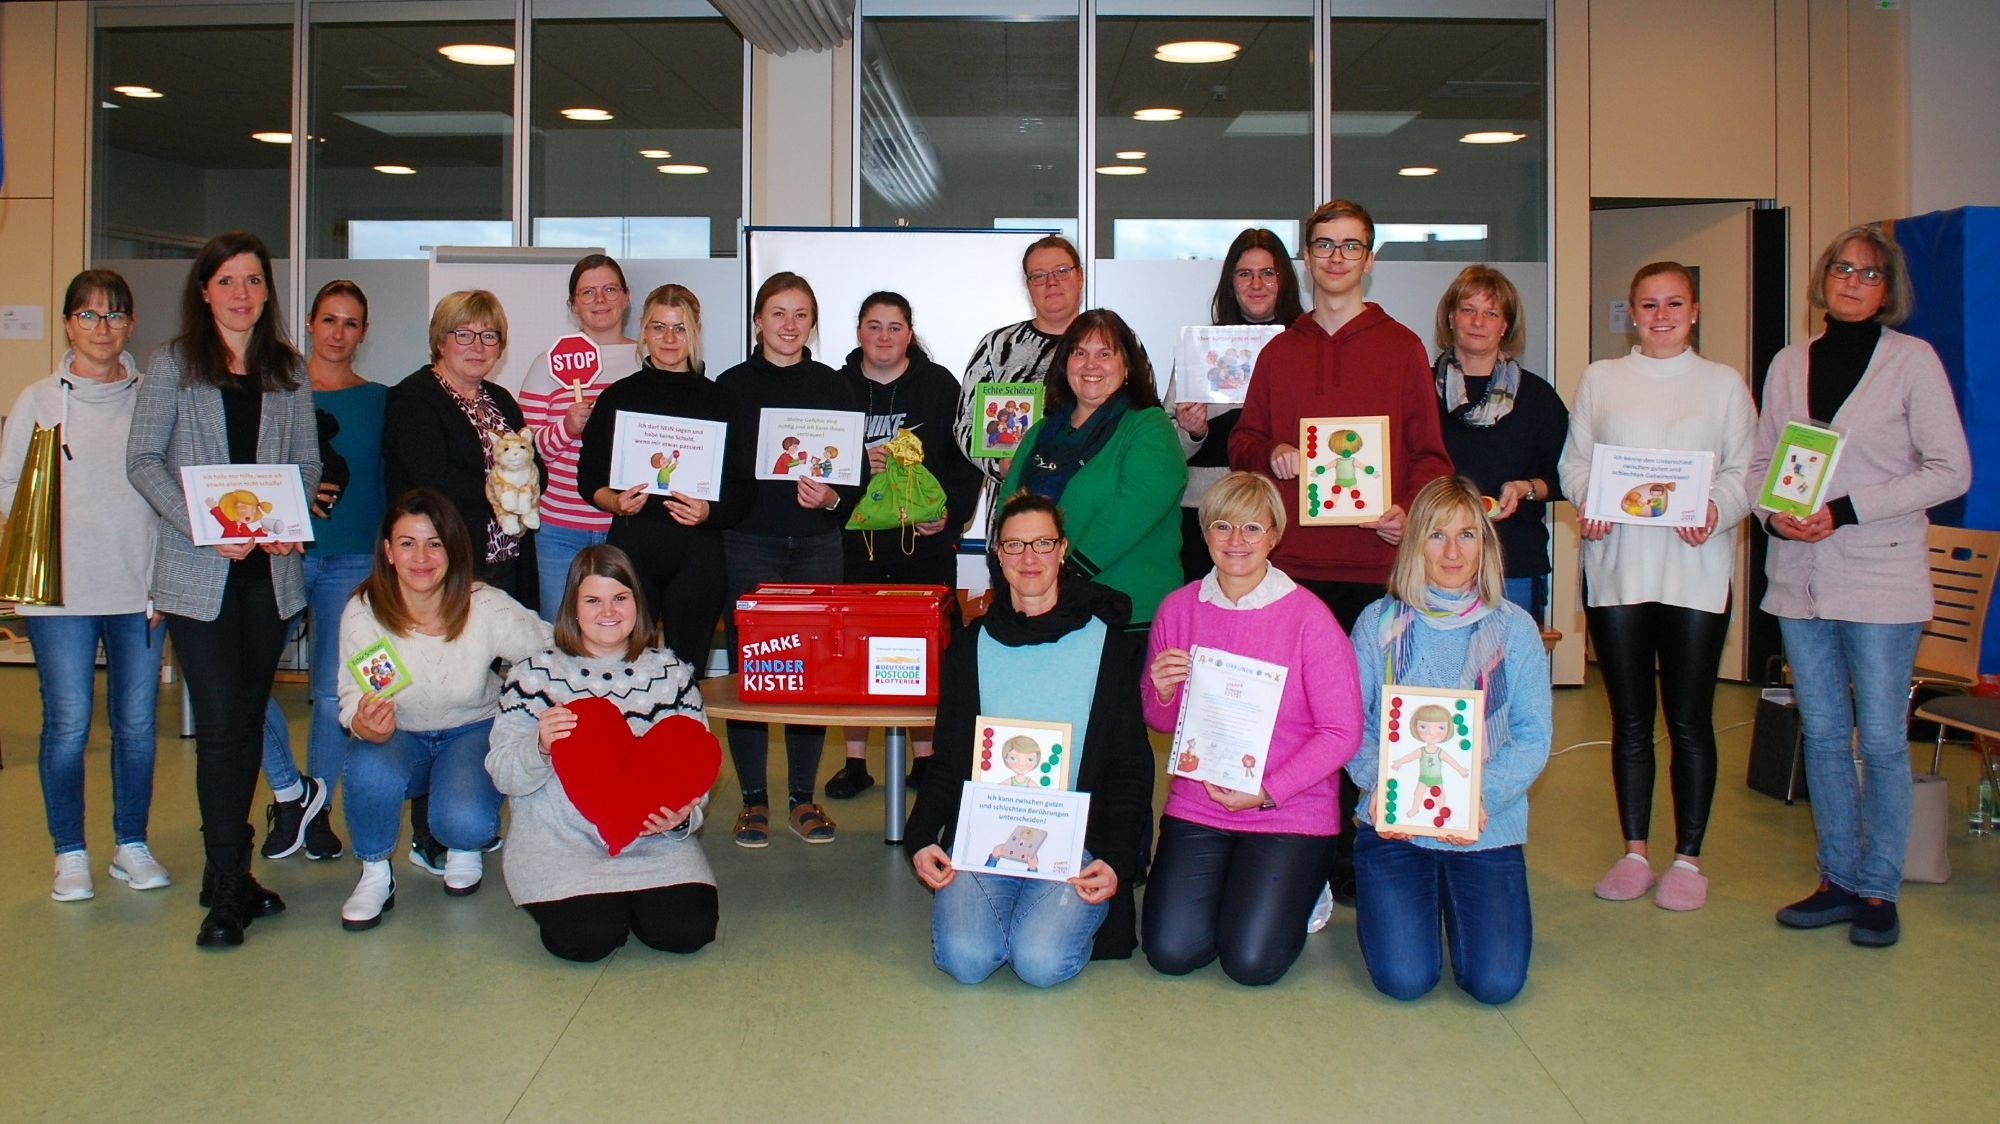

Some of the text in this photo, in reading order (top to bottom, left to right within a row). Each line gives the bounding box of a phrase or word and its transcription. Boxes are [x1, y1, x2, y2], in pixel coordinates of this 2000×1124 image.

[552, 351, 596, 372] STOP
[983, 386, 1036, 394] Echte Schätze!
[742, 634, 801, 658] STARKE
[744, 660, 804, 673] KINDER
[876, 671, 920, 679] POSTCODE
[744, 674, 804, 691] KISTE!
[1015, 797, 1044, 805] zwischen
[993, 803, 1026, 812] schlechten
[1027, 808, 1069, 817] Berührungen
[999, 814, 1047, 823] unterscheiden!
